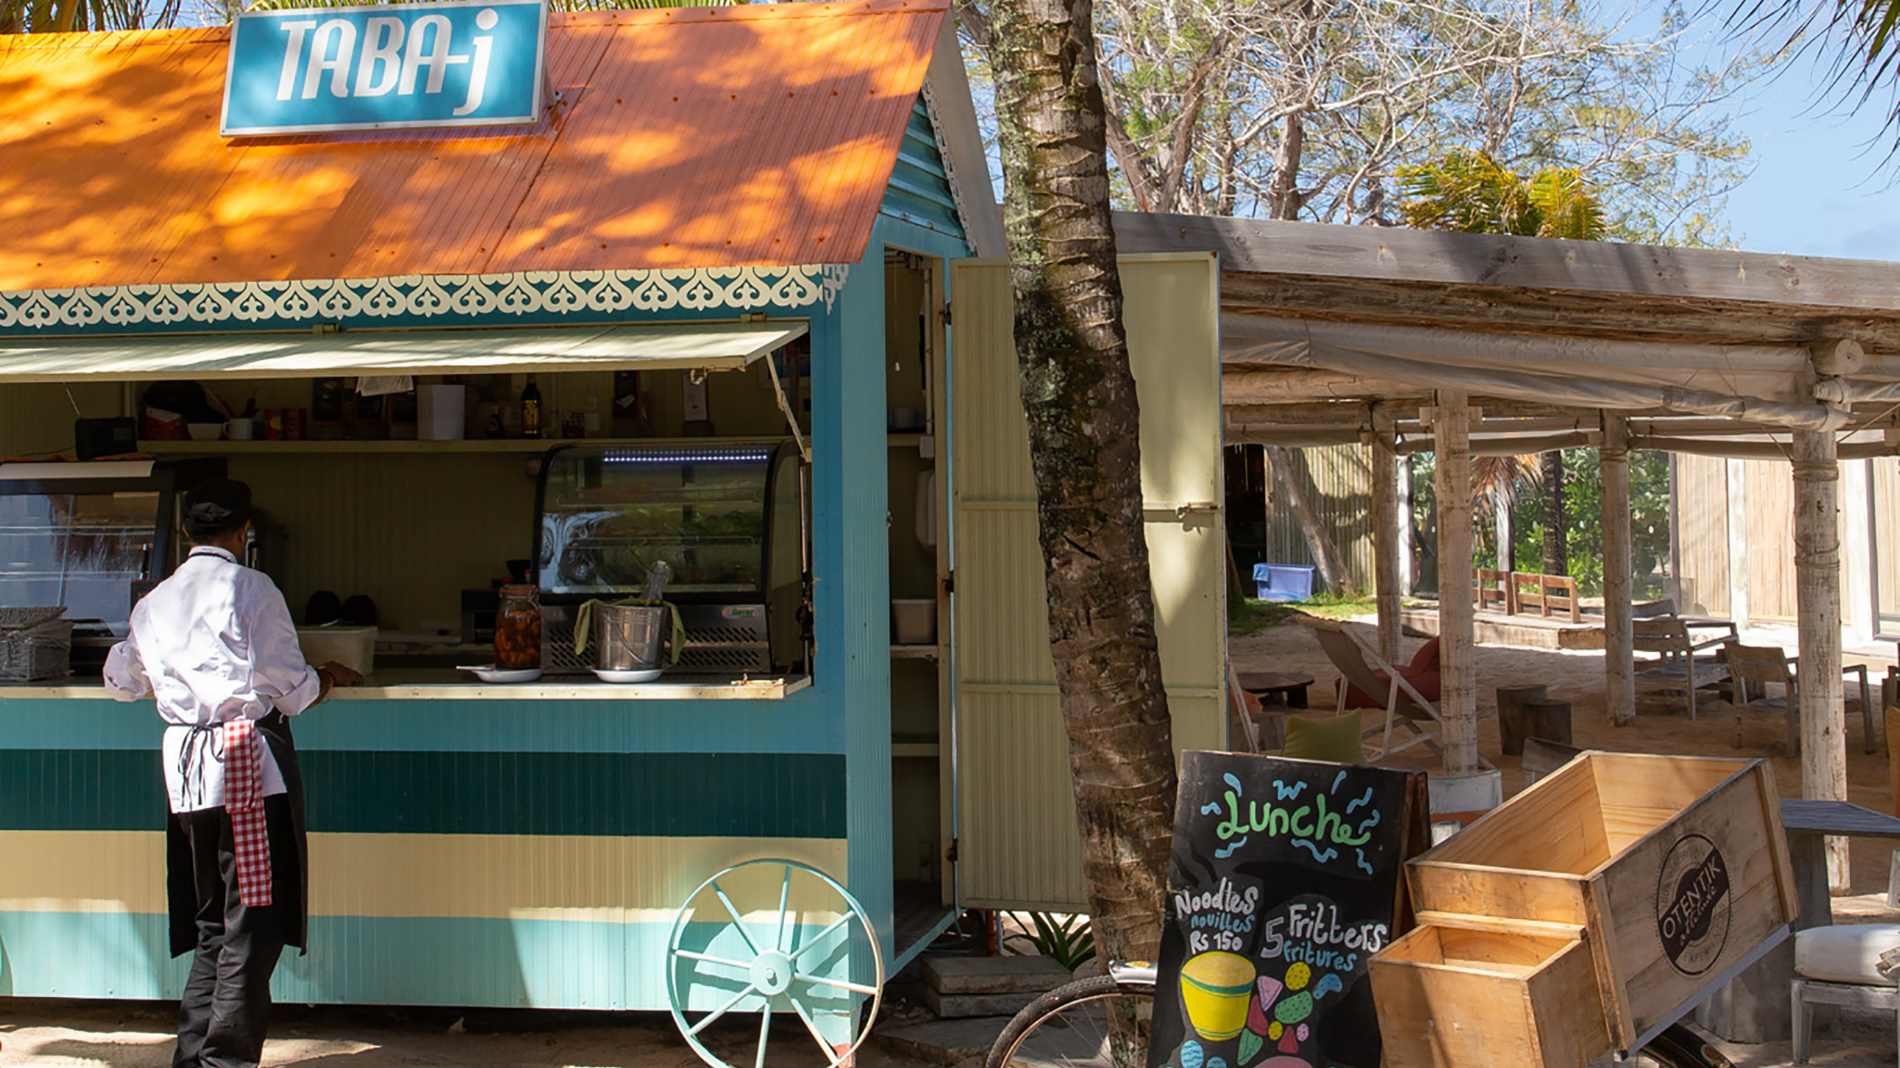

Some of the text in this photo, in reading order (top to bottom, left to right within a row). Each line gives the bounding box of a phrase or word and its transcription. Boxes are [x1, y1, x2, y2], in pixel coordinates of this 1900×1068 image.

[1175, 876, 1259, 919] Noodles
[1663, 855, 1721, 939] OTENTIK
[1190, 930, 1242, 955] Rs 150
[1260, 902, 1387, 958] 5 Fritters
